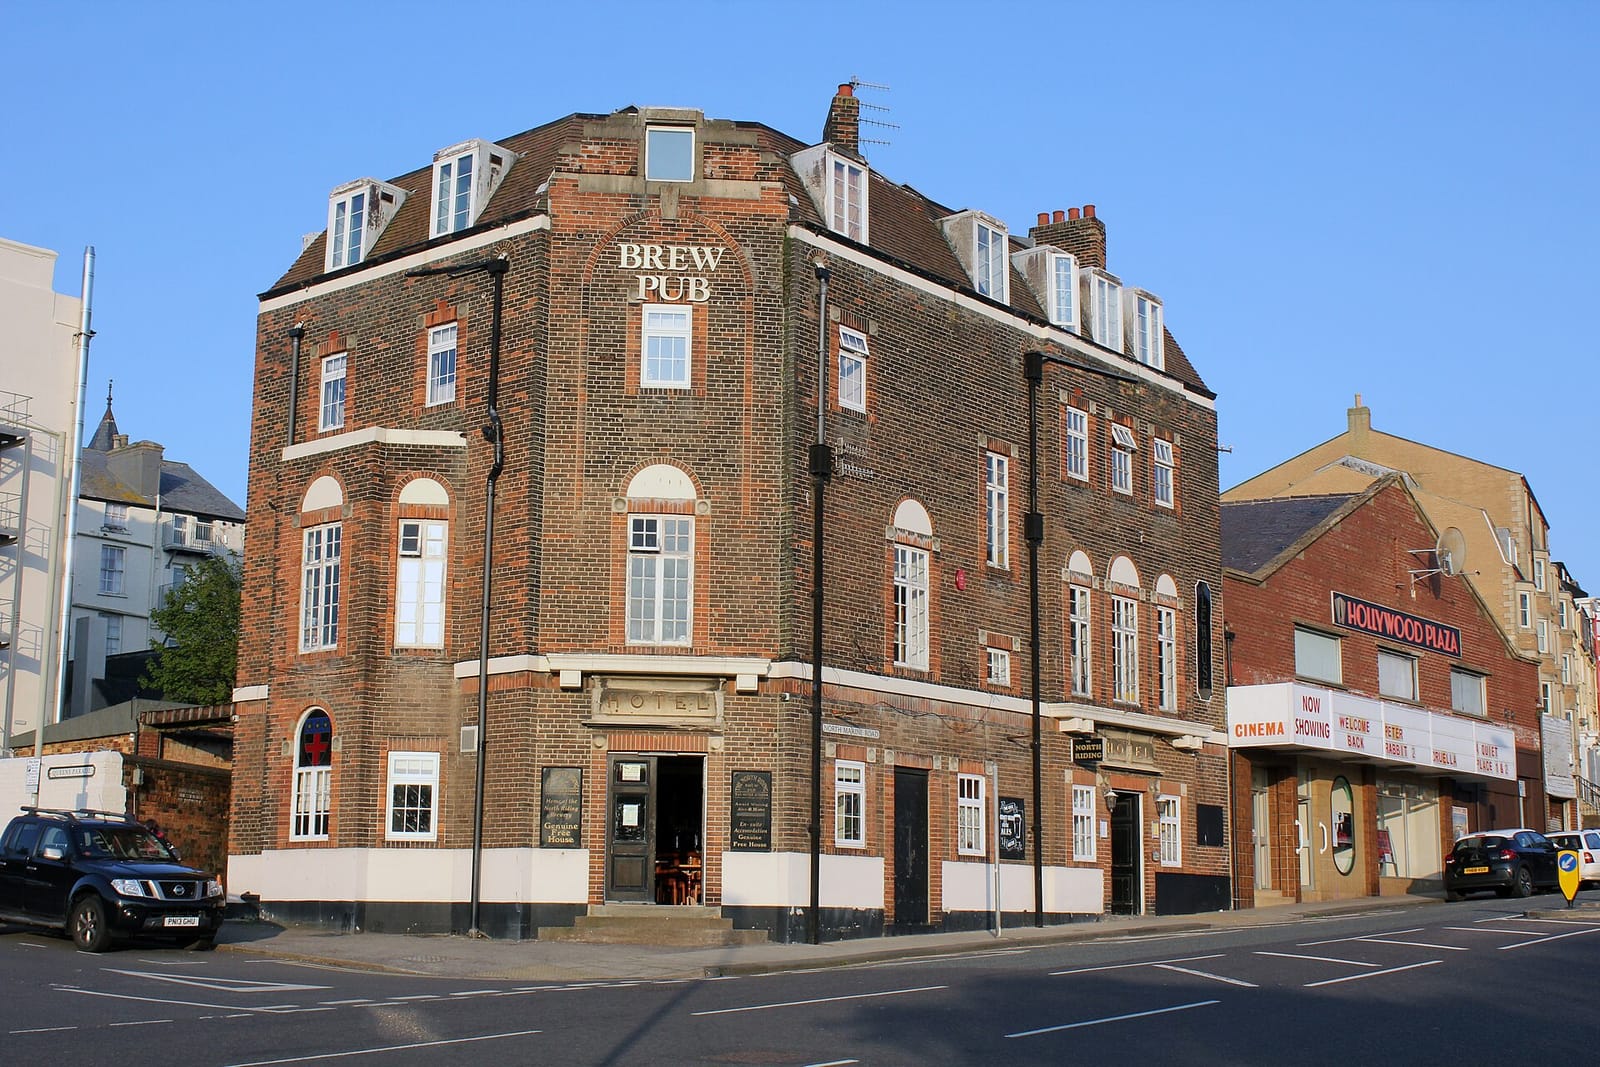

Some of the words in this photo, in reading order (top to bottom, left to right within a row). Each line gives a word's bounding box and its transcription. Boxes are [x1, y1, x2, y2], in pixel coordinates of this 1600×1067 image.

[617, 243, 726, 272] BREW
[635, 275, 711, 302] PUB
[1347, 601, 1423, 643] HOLLYWOOD
[1425, 624, 1459, 654] PLAZA
[607, 694, 709, 711] HOTEL
[1302, 695, 1321, 713] NOW
[823, 724, 842, 734] NORTH
[843, 726, 865, 736] MARINE
[1235, 721, 1285, 737] CINEMA
[1295, 718, 1330, 739] SHOWING
[1339, 716, 1370, 733] WELCOME
[1075, 743, 1102, 751] NORTH
[1347, 735, 1365, 749] BACK
[1075, 752, 1102, 760] RIDING
[1107, 742, 1150, 759] HOEL
[1411, 746, 1416, 759] 2
[1481, 744, 1498, 757] QUIET
[544, 822, 579, 830] Genuine
[551, 829, 571, 837] Free
[548, 835, 575, 843] House
